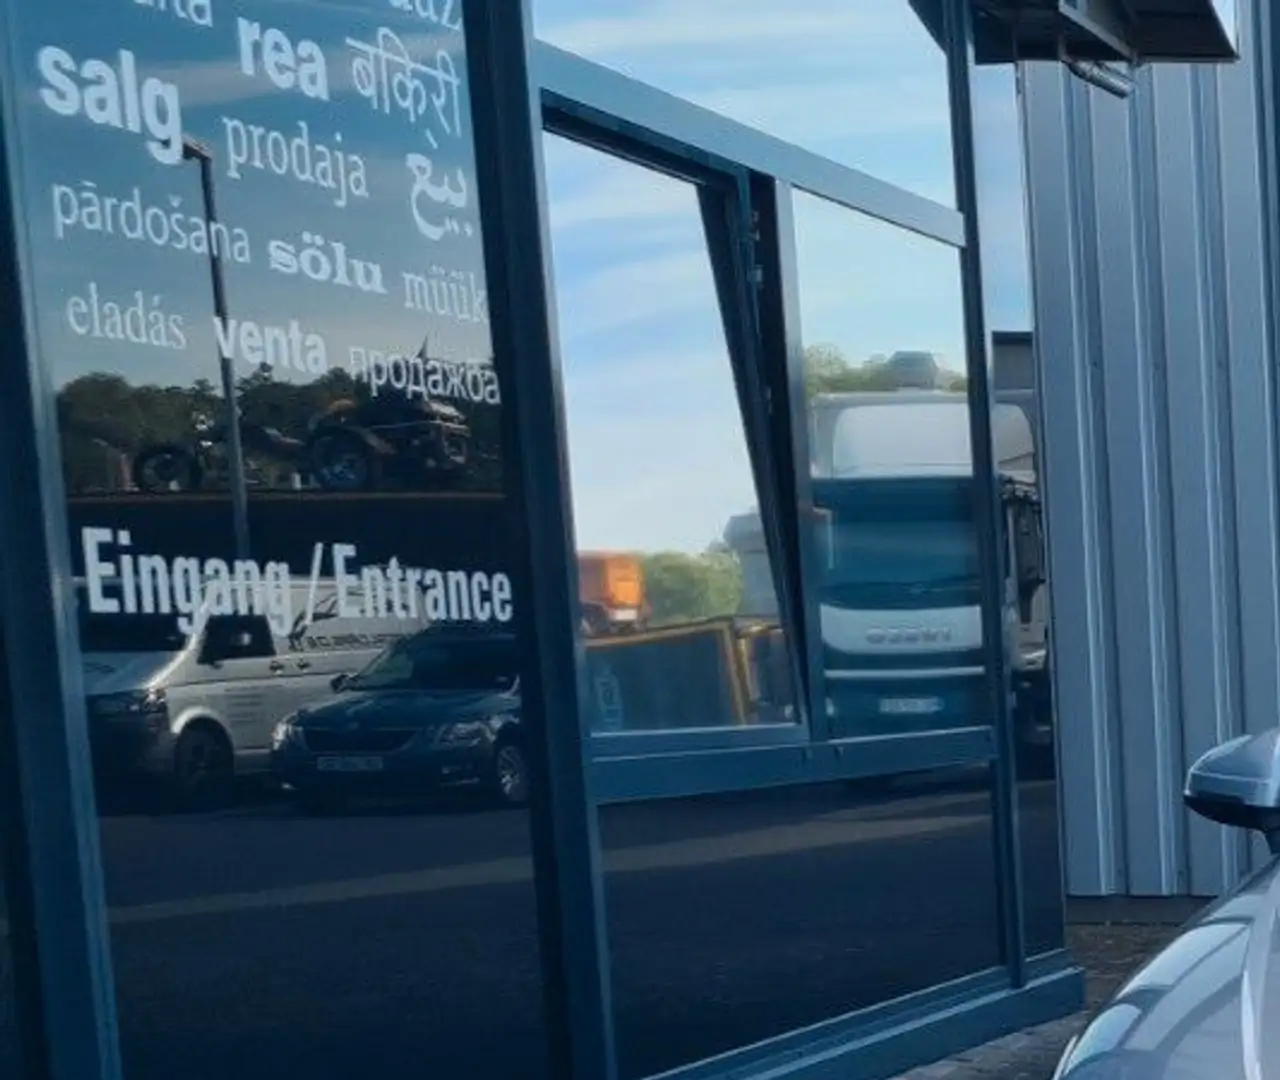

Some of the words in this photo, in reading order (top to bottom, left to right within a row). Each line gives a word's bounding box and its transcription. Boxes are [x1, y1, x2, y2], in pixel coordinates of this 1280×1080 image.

[237, 17, 330, 101] rea
[37, 45, 184, 165] salg
[220, 115, 370, 207] prodaja
[52, 180, 251, 265] pārdošana
[268, 231, 388, 295] sölu
[67, 282, 187, 351] eladás
[213, 315, 328, 374] venta
[349, 347, 501, 404] продажба
[82, 526, 291, 636] Eingang
